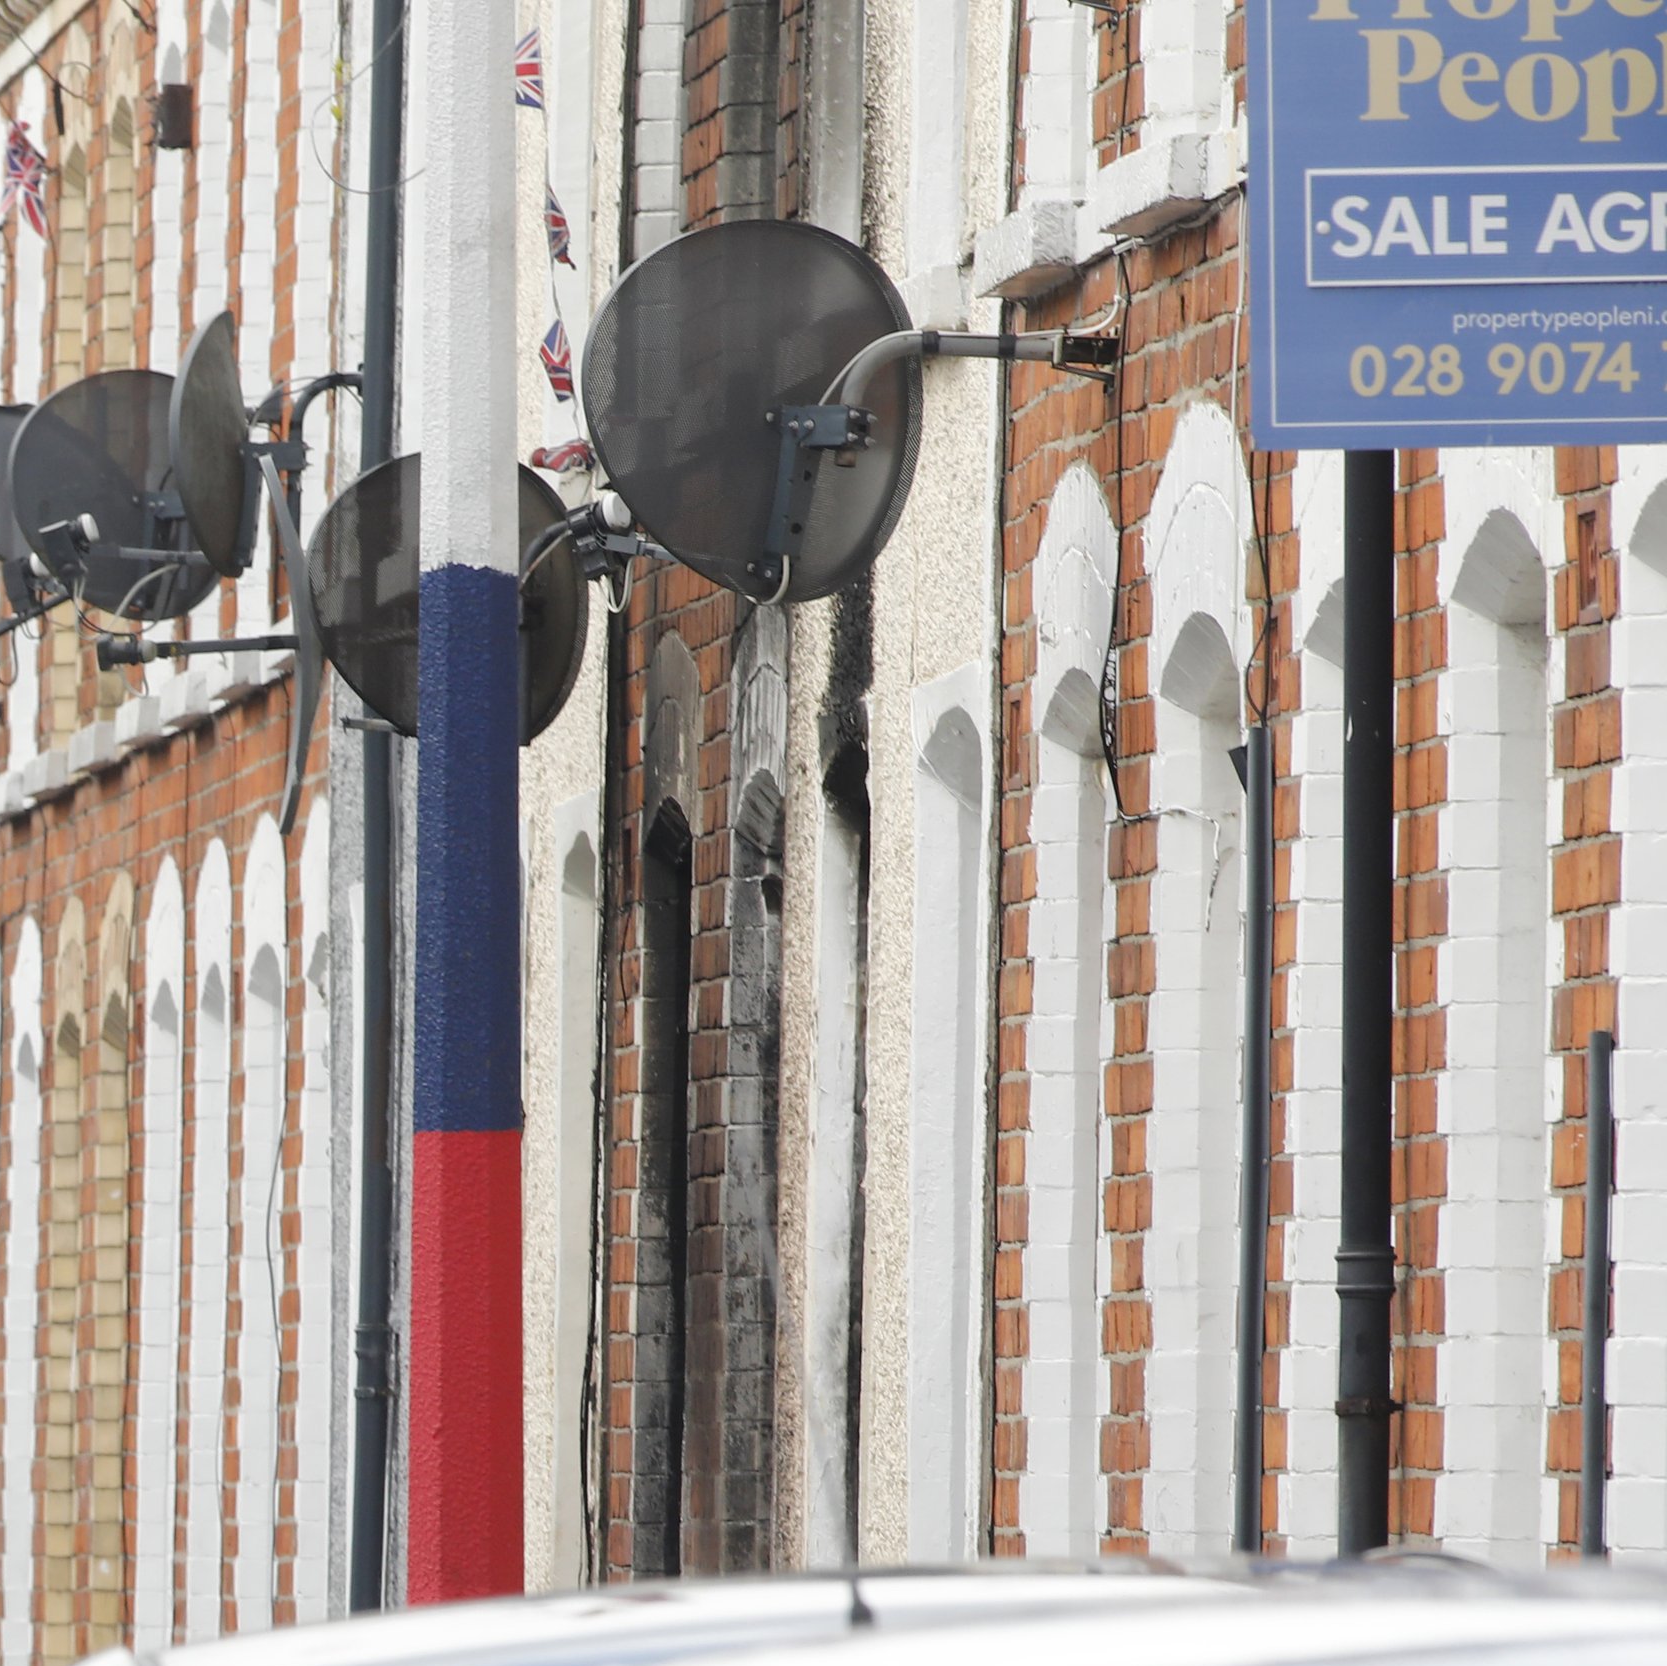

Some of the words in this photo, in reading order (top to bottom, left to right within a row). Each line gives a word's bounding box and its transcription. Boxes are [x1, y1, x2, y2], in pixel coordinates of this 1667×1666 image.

[1331, 195, 1509, 258] SALE
[1349, 344, 1465, 398] 028
[1487, 341, 1641, 395] 9074
